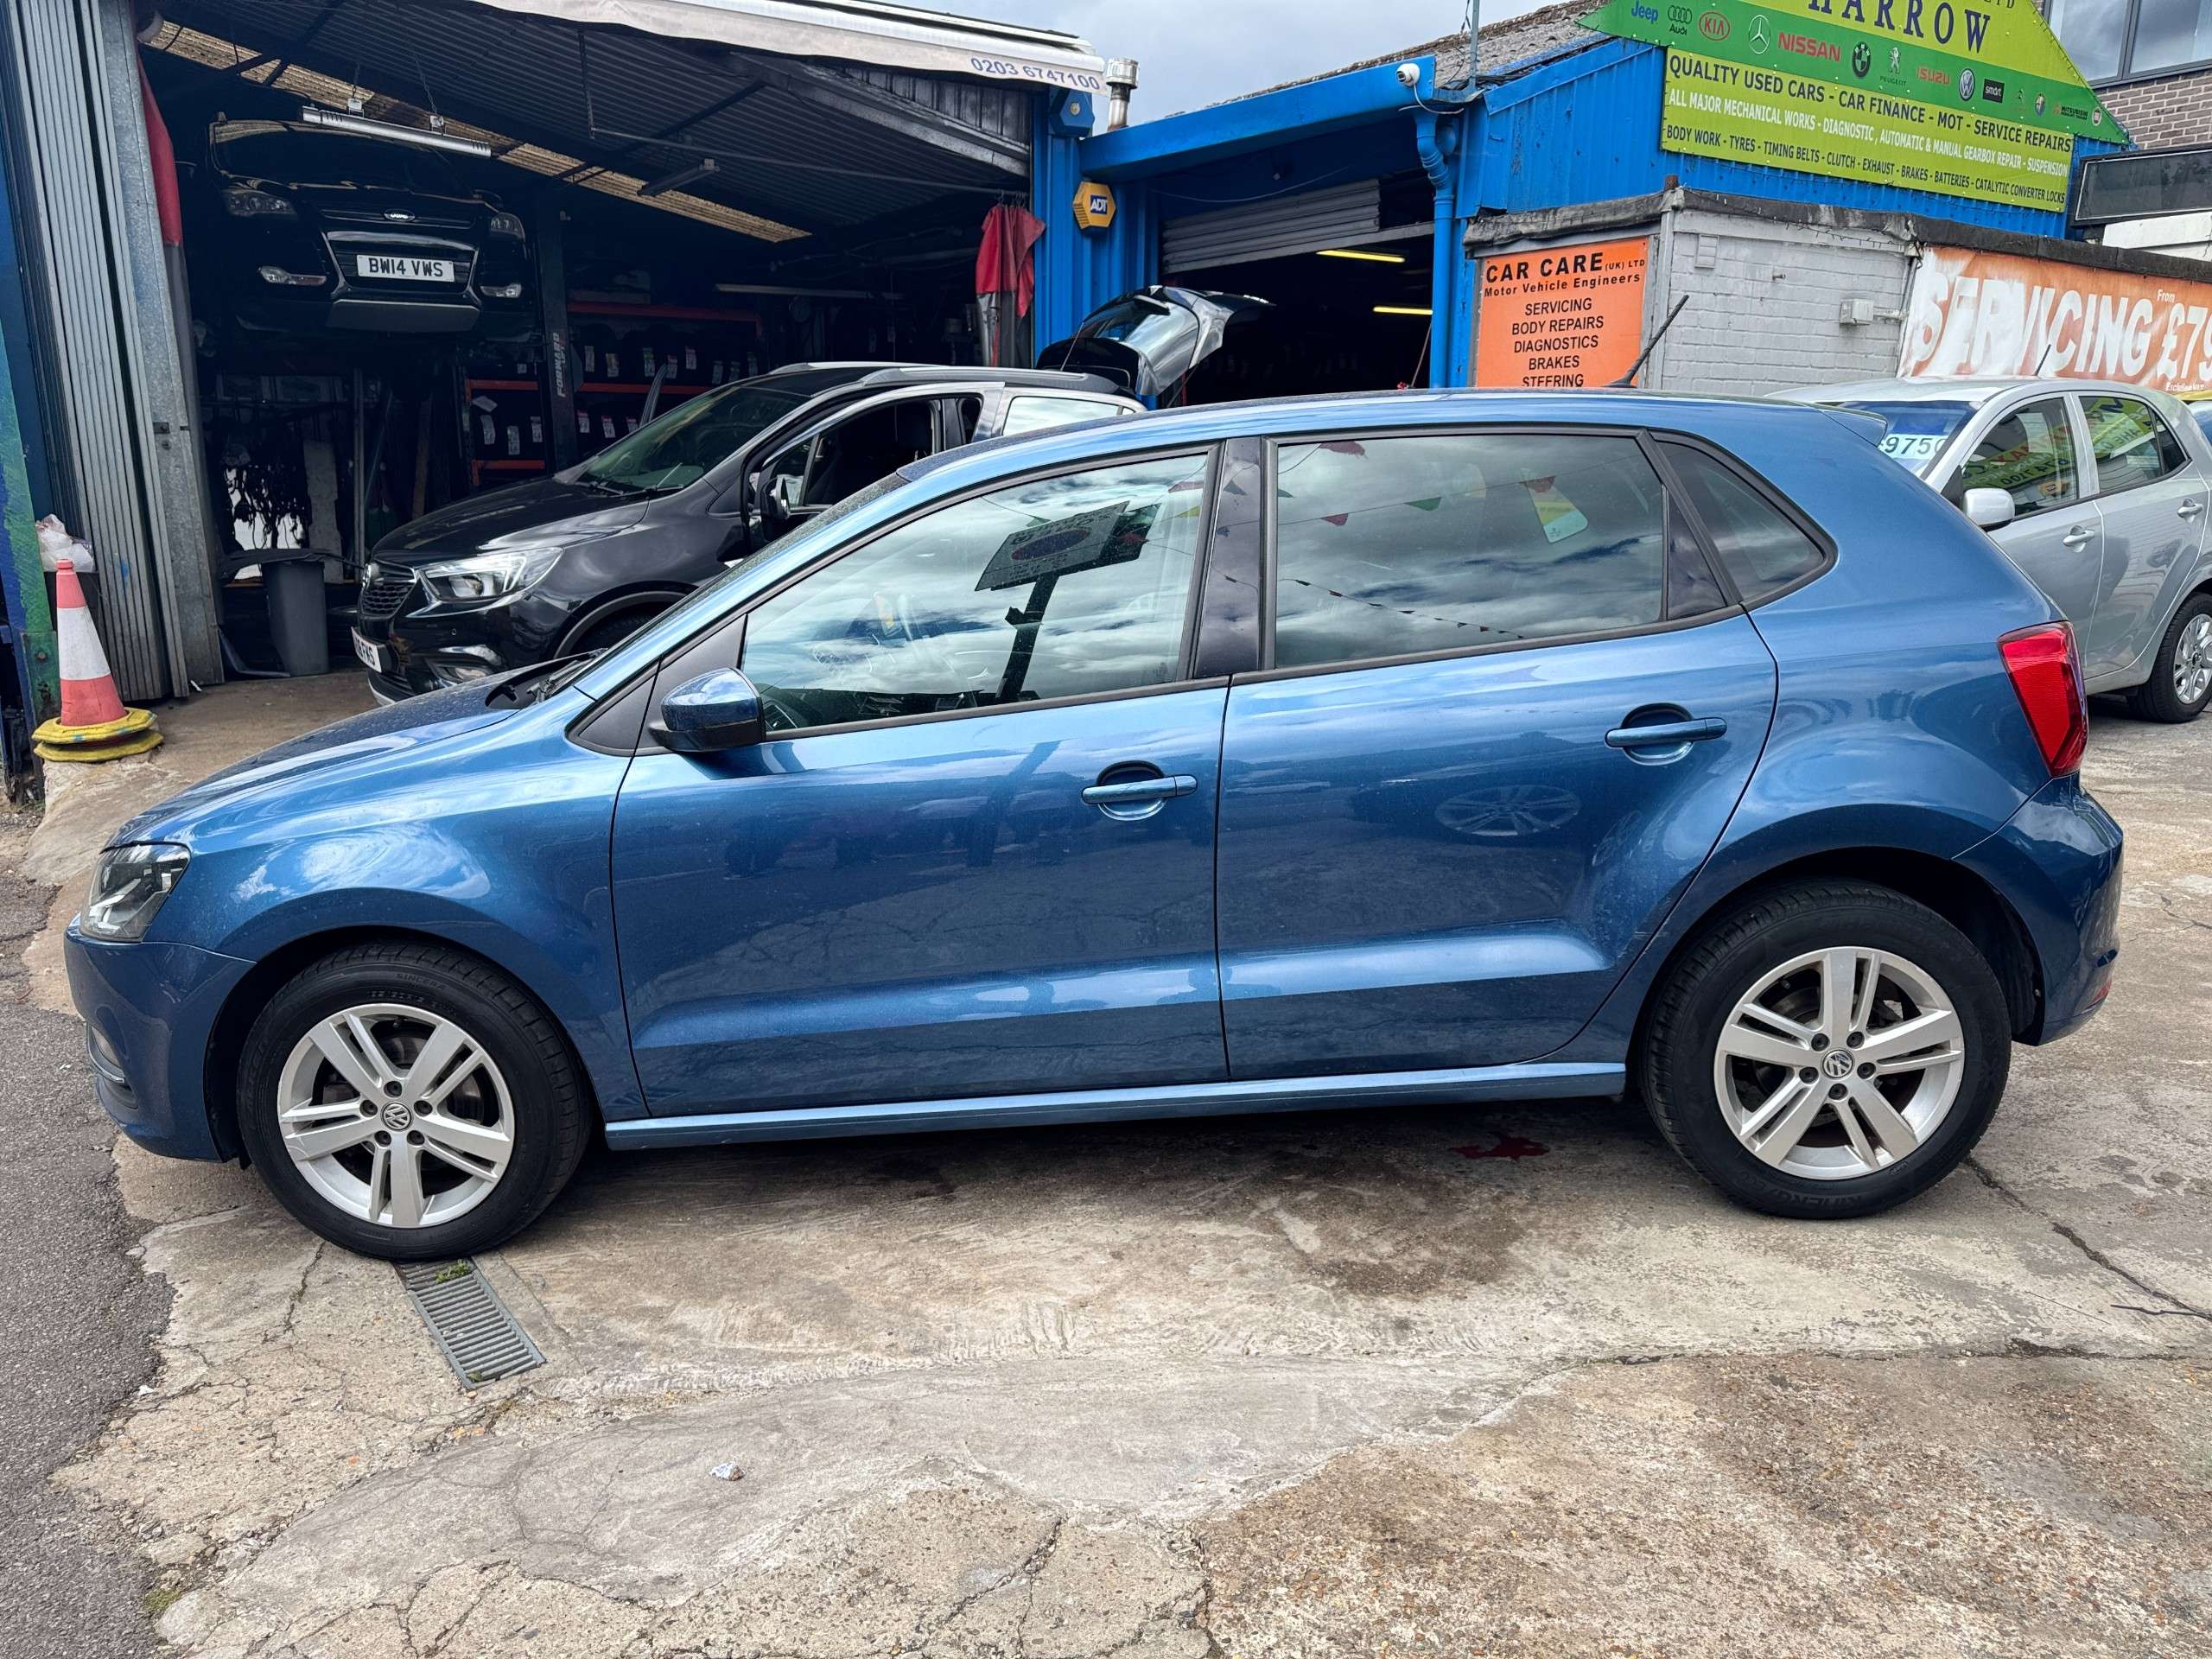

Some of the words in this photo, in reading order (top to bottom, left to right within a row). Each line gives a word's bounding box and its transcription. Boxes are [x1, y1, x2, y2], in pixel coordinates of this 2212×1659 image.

[1631, 1, 1658, 24] Jeep
[1669, 23, 1688, 35] Audi
[1704, 17, 1725, 35] KIA
[1777, 32, 1840, 62] NISSAN
[970, 58, 1019, 75] 0203
[1023, 66, 1100, 90] 6747100
[1916, 67, 1950, 86] ISUZU
[1669, 55, 1740, 86] QUALITY
[1744, 70, 1783, 93] USED
[1788, 80, 1825, 102] CARS
[1839, 91, 1865, 111] CAR
[1869, 99, 1925, 124] FINANCE
[1937, 111, 1964, 130] MOT
[1974, 119, 2021, 143] SERVICE
[2024, 131, 2071, 152] REPAIRS
[1669, 88, 1687, 107] ALL
[1689, 92, 1721, 113] MAJOR
[1724, 99, 1782, 124] MECHANICAL
[1784, 110, 1815, 130] WORKS
[1879, 130, 1924, 151] AUTOMATIC
[1925, 139, 1931, 152] &
[1933, 140, 1962, 158] MANUAL
[1964, 145, 1996, 164] GEARBOX
[1997, 151, 2021, 169] REPAIR
[2027, 157, 2068, 176] SUSPENSION
[1667, 124, 1692, 142] BODY
[1694, 130, 1721, 147] WORK
[1730, 136, 1756, 152] TYRES
[1764, 141, 1794, 158] TIMING
[1796, 147, 1820, 162] BELTS
[1827, 152, 1855, 168] CLUTCH
[1863, 158, 1895, 175] EXHAUST
[1901, 165, 1928, 181] BRAKES
[1934, 171, 1970, 188] BATTERIES
[1975, 178, 2009, 194] CATALYTIC
[2011, 186, 2045, 200] CONVERTER
[2046, 193, 2065, 204] LOCKS
[1091, 198, 1108, 213] ADT
[368, 257, 406, 275] BW14
[411, 260, 443, 276] VWS
[1486, 262, 1529, 283] CAR
[1540, 252, 1604, 276] CARE
[1605, 262, 1624, 271] (UK)
[1628, 259, 1645, 268] LTD
[1484, 286, 1517, 297] Motor
[1522, 280, 1567, 293] Vehicle
[1573, 274, 1640, 289] Engineers
[2157, 289, 2175, 303] From
[1525, 297, 1592, 316] SERVICING
[1512, 321, 1546, 335] BODY
[1549, 315, 1604, 333] REPAIRS
[1911, 271, 2153, 377] SERVICING
[1514, 334, 1599, 353] DIAGNOSTICS
[1529, 355, 1580, 370] BRAKES
[1522, 373, 1584, 387] STEERING
[1879, 436, 1948, 455] 9750
